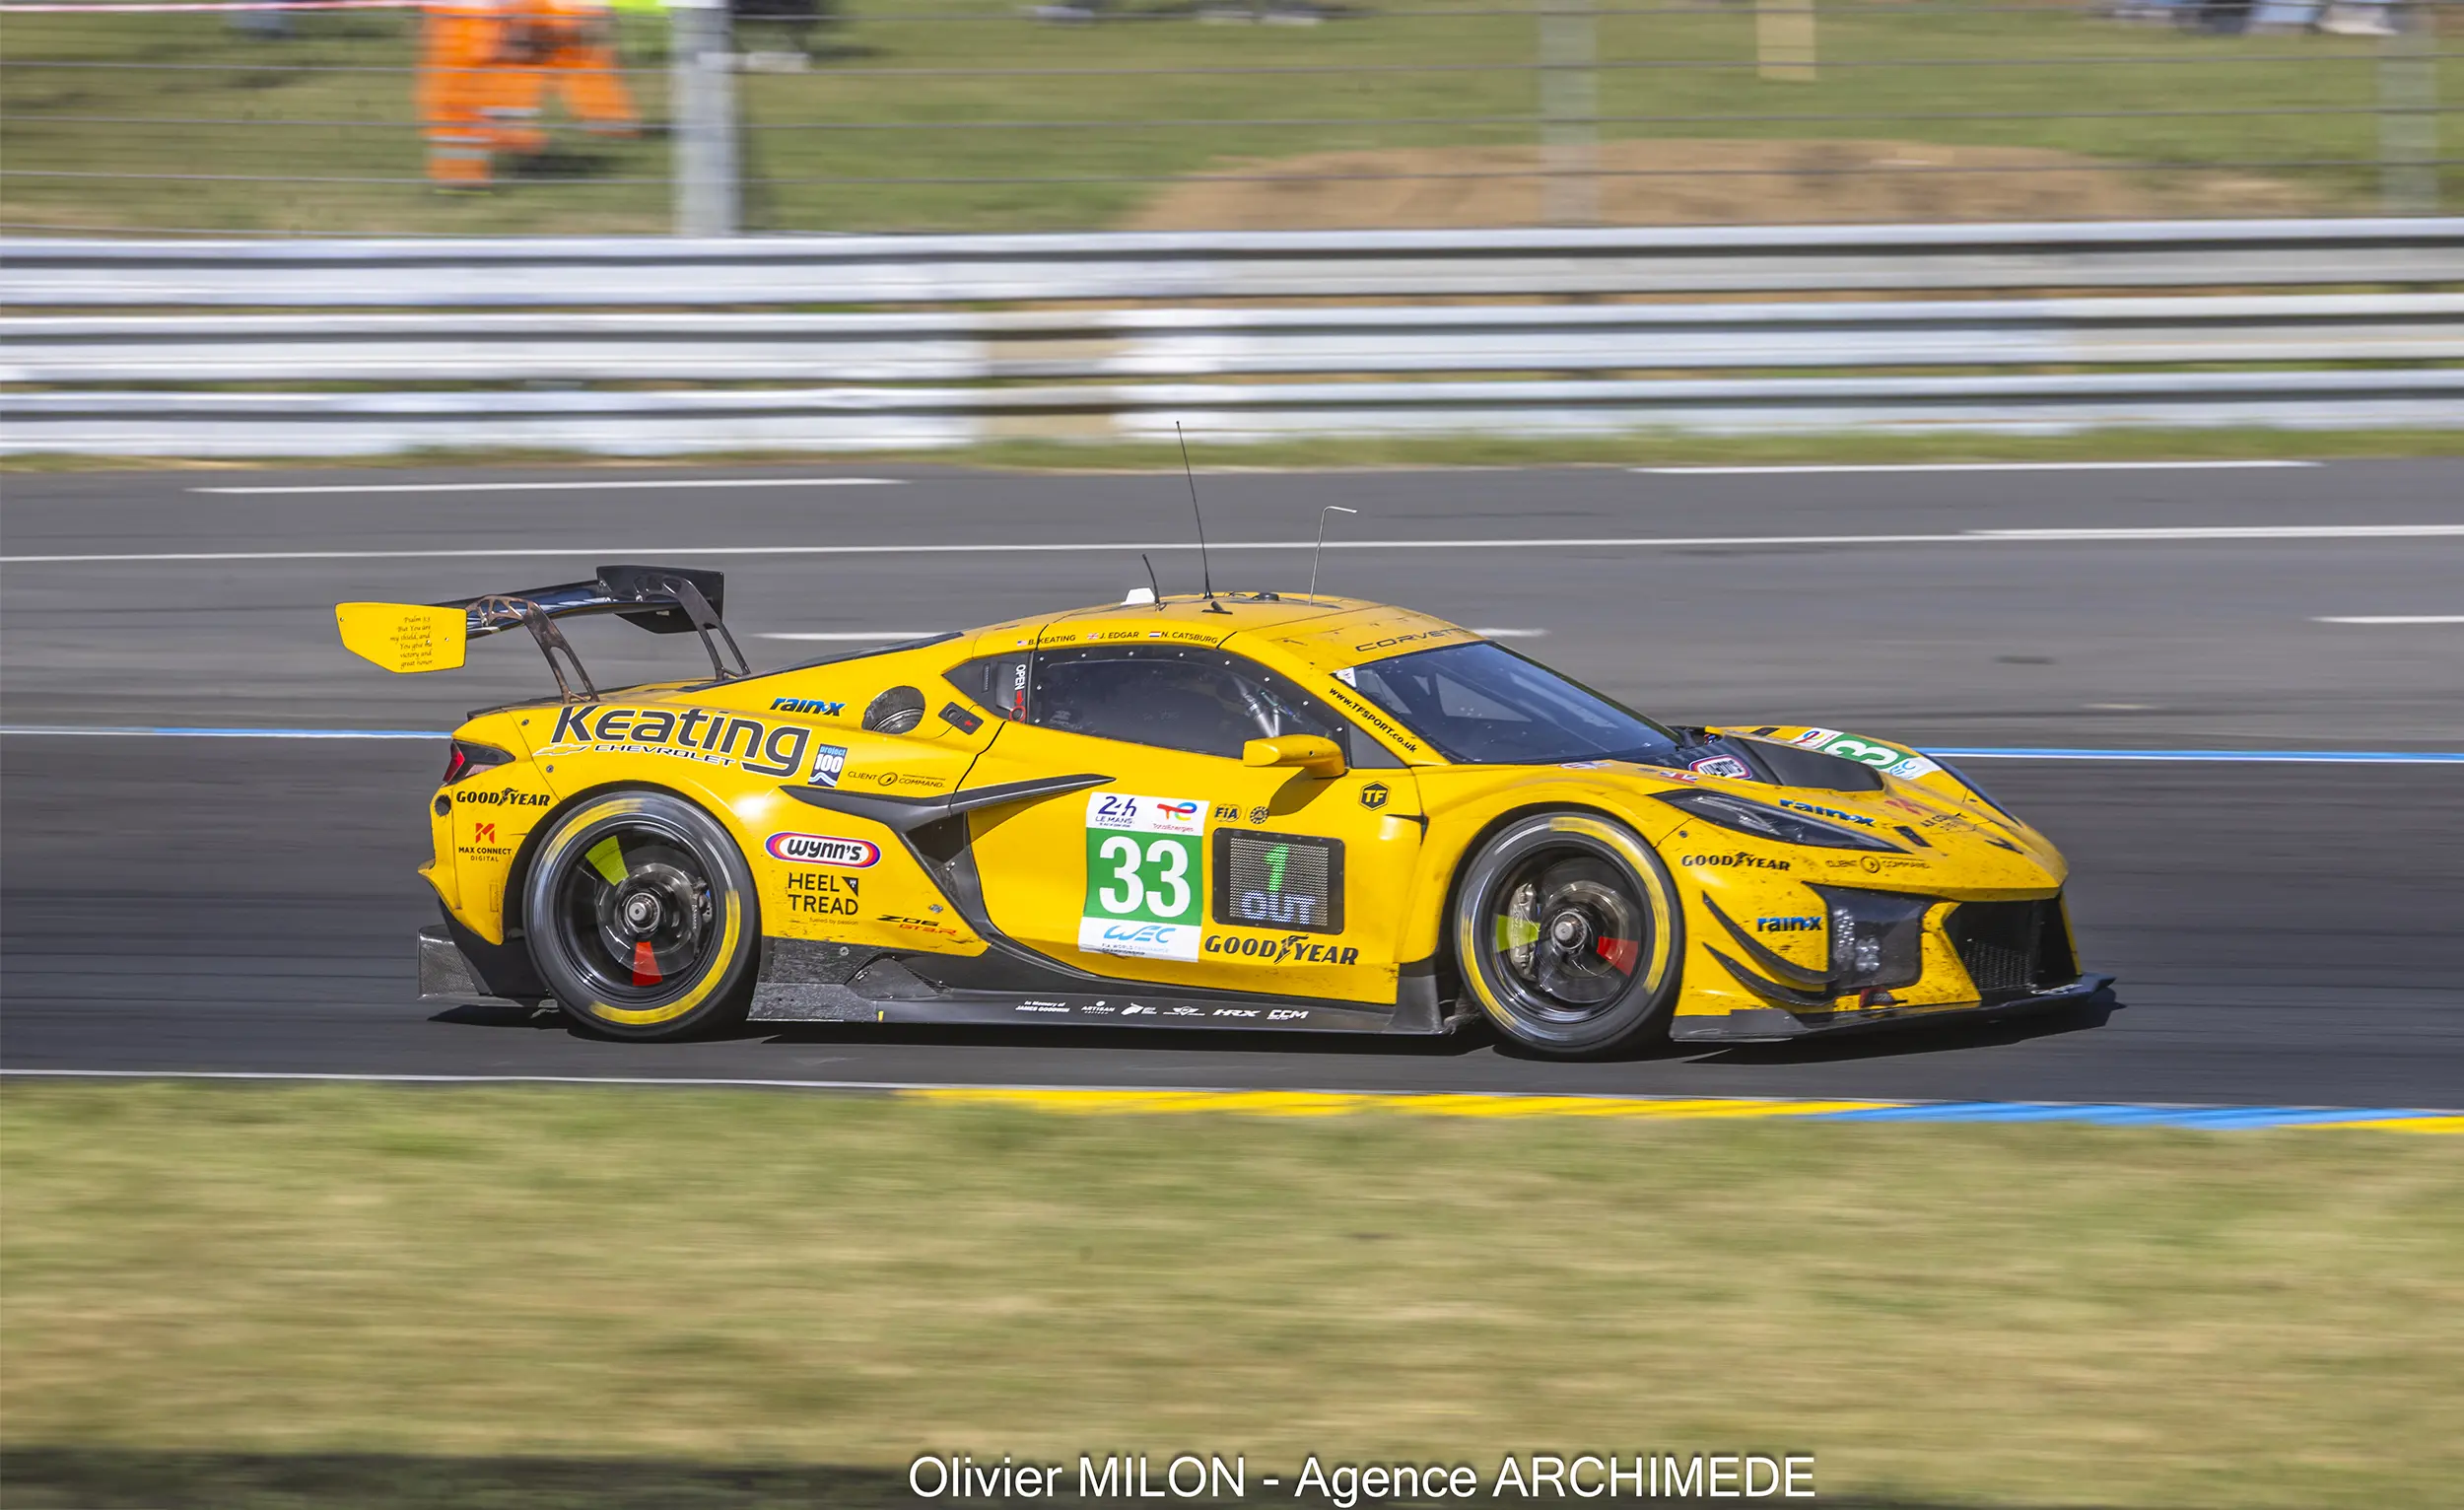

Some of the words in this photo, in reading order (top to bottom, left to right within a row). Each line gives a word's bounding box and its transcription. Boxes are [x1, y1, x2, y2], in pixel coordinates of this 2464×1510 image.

[1028, 637, 1036, 646] B.
[1038, 634, 1076, 645] KEATING
[1108, 631, 1139, 640] EDGAR
[1172, 631, 1218, 645] CATSBURG
[1015, 663, 1027, 691] OPEN
[1329, 687, 1417, 753] www.TFSPORT.co.uk
[551, 704, 810, 779] Keating
[819, 745, 847, 757] project
[594, 744, 737, 768] CHEVROLET
[814, 754, 844, 774] 100
[848, 771, 878, 781] CLIENT
[456, 789, 550, 806] GOODYEAR
[1364, 789, 1388, 803] TF
[477, 847, 513, 856] CONNECT
[1263, 843, 1290, 892] 1
[1681, 853, 1790, 871] GOODYEAR
[787, 871, 840, 892] HEEL
[1099, 836, 1191, 918] 33
[787, 894, 858, 916] TREAD
[1241, 890, 1316, 925] OUT
[1104, 926, 1177, 943] WEC
[1204, 935, 1359, 966] GOODYEAR
